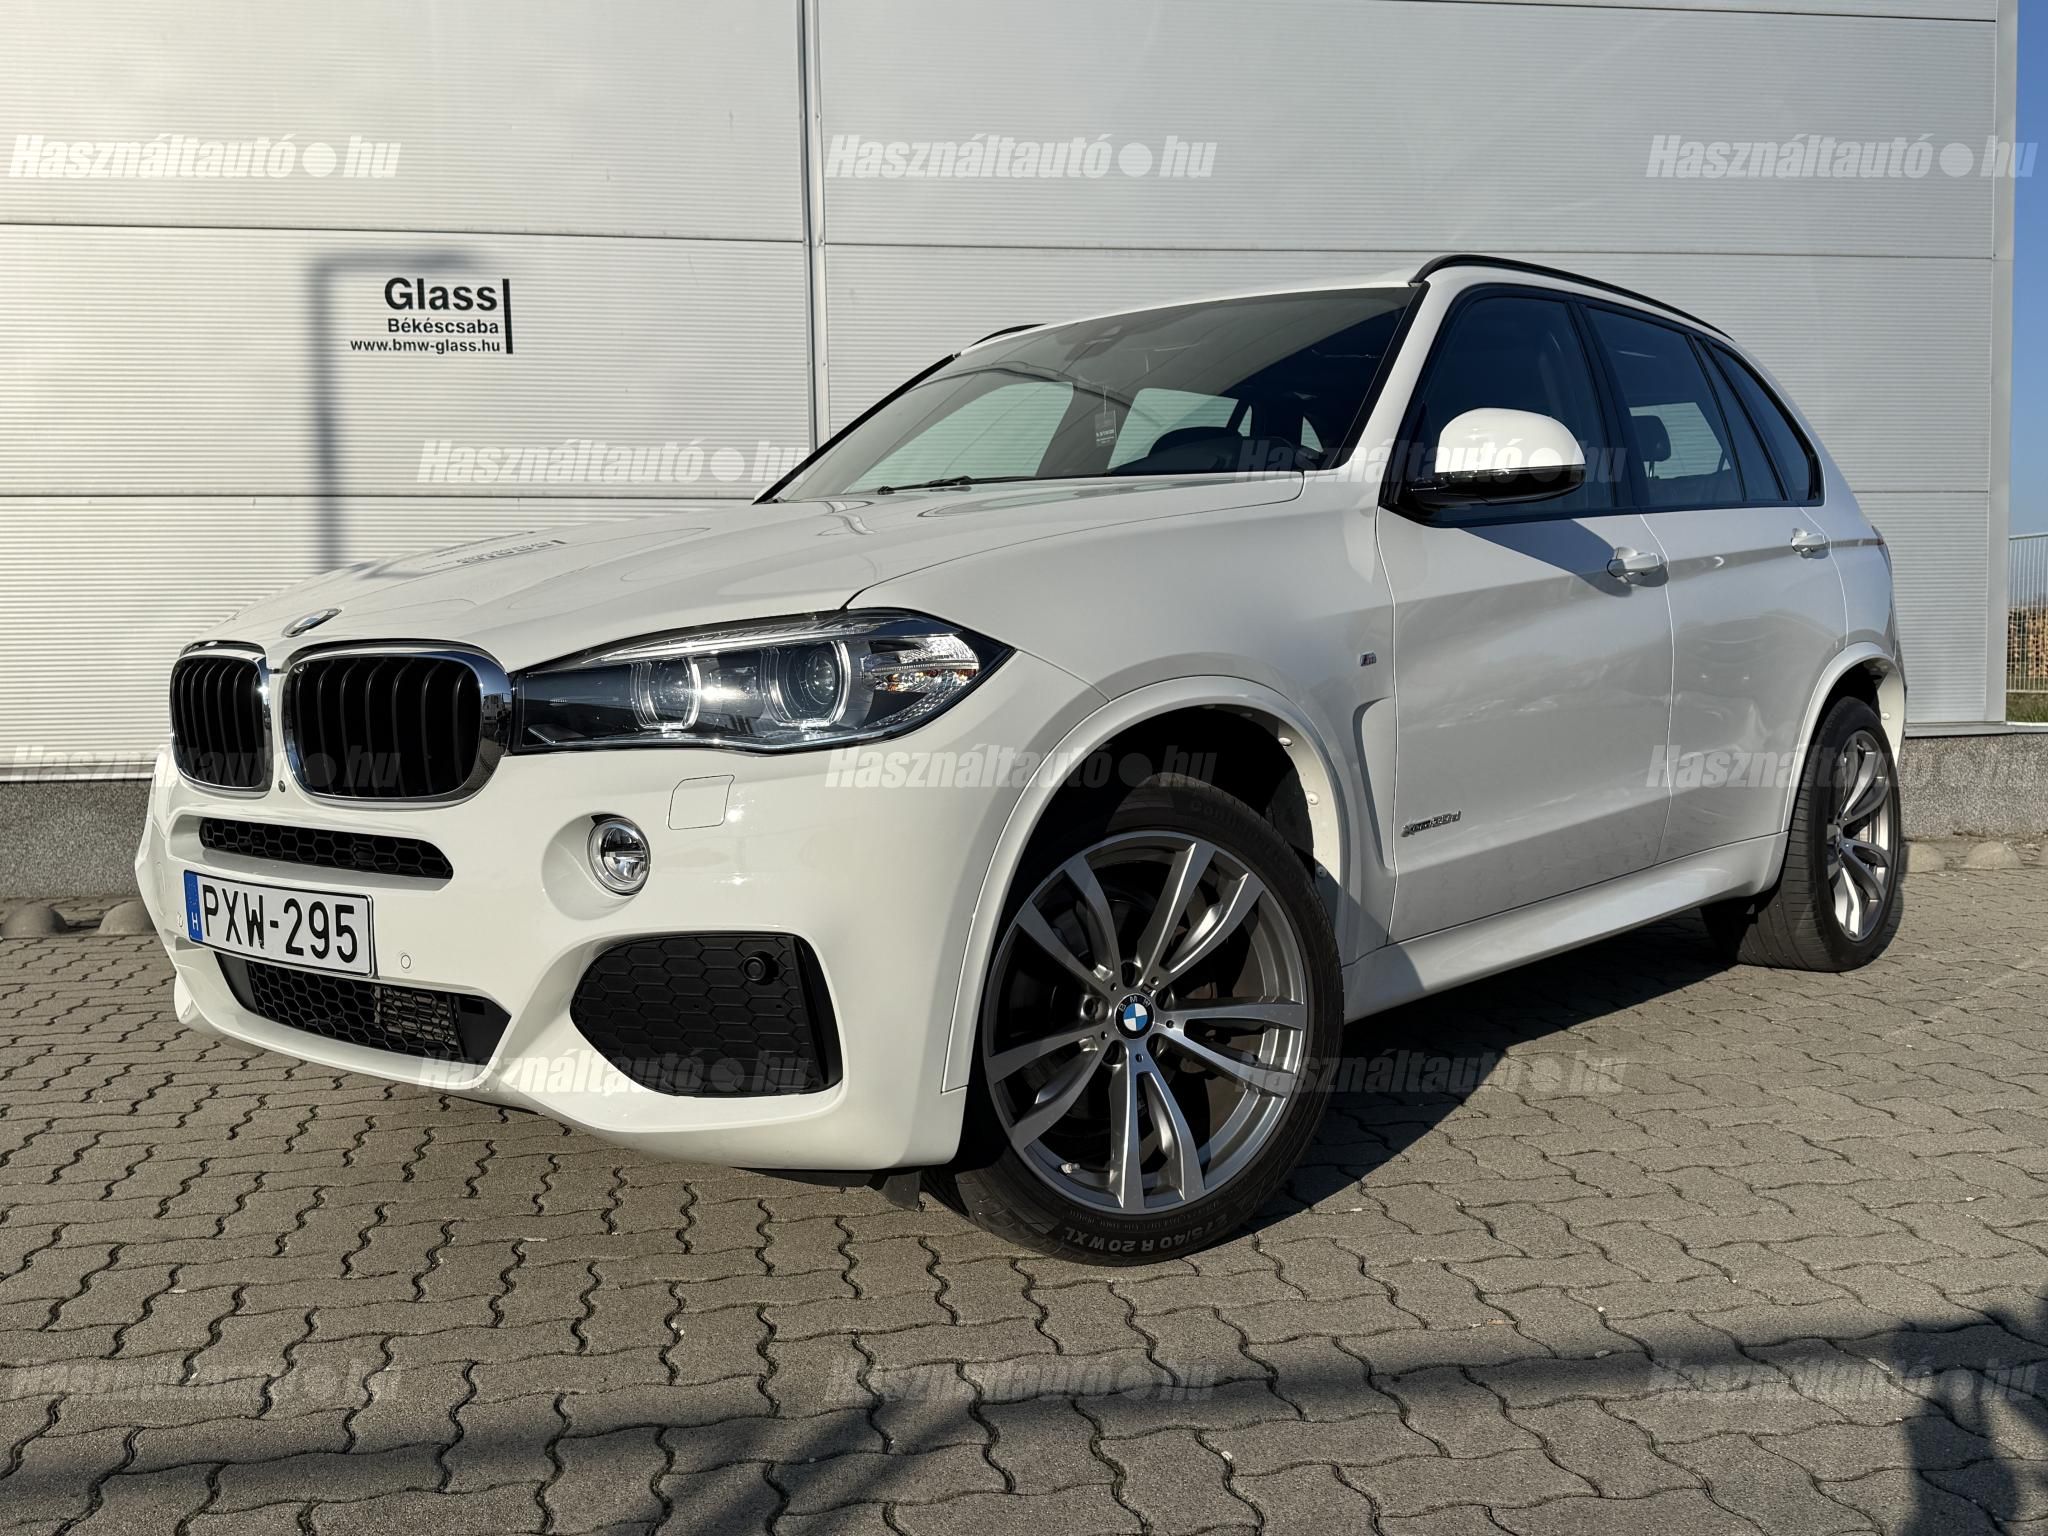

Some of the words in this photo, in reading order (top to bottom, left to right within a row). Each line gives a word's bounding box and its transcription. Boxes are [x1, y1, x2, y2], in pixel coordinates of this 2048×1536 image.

[384, 277, 498, 312] Glass
[388, 317, 499, 334] Békéscsaba
[350, 338, 500, 355] www.bmw-glass.hu
[191, 911, 199, 931] H
[202, 884, 358, 963] PXW-295
